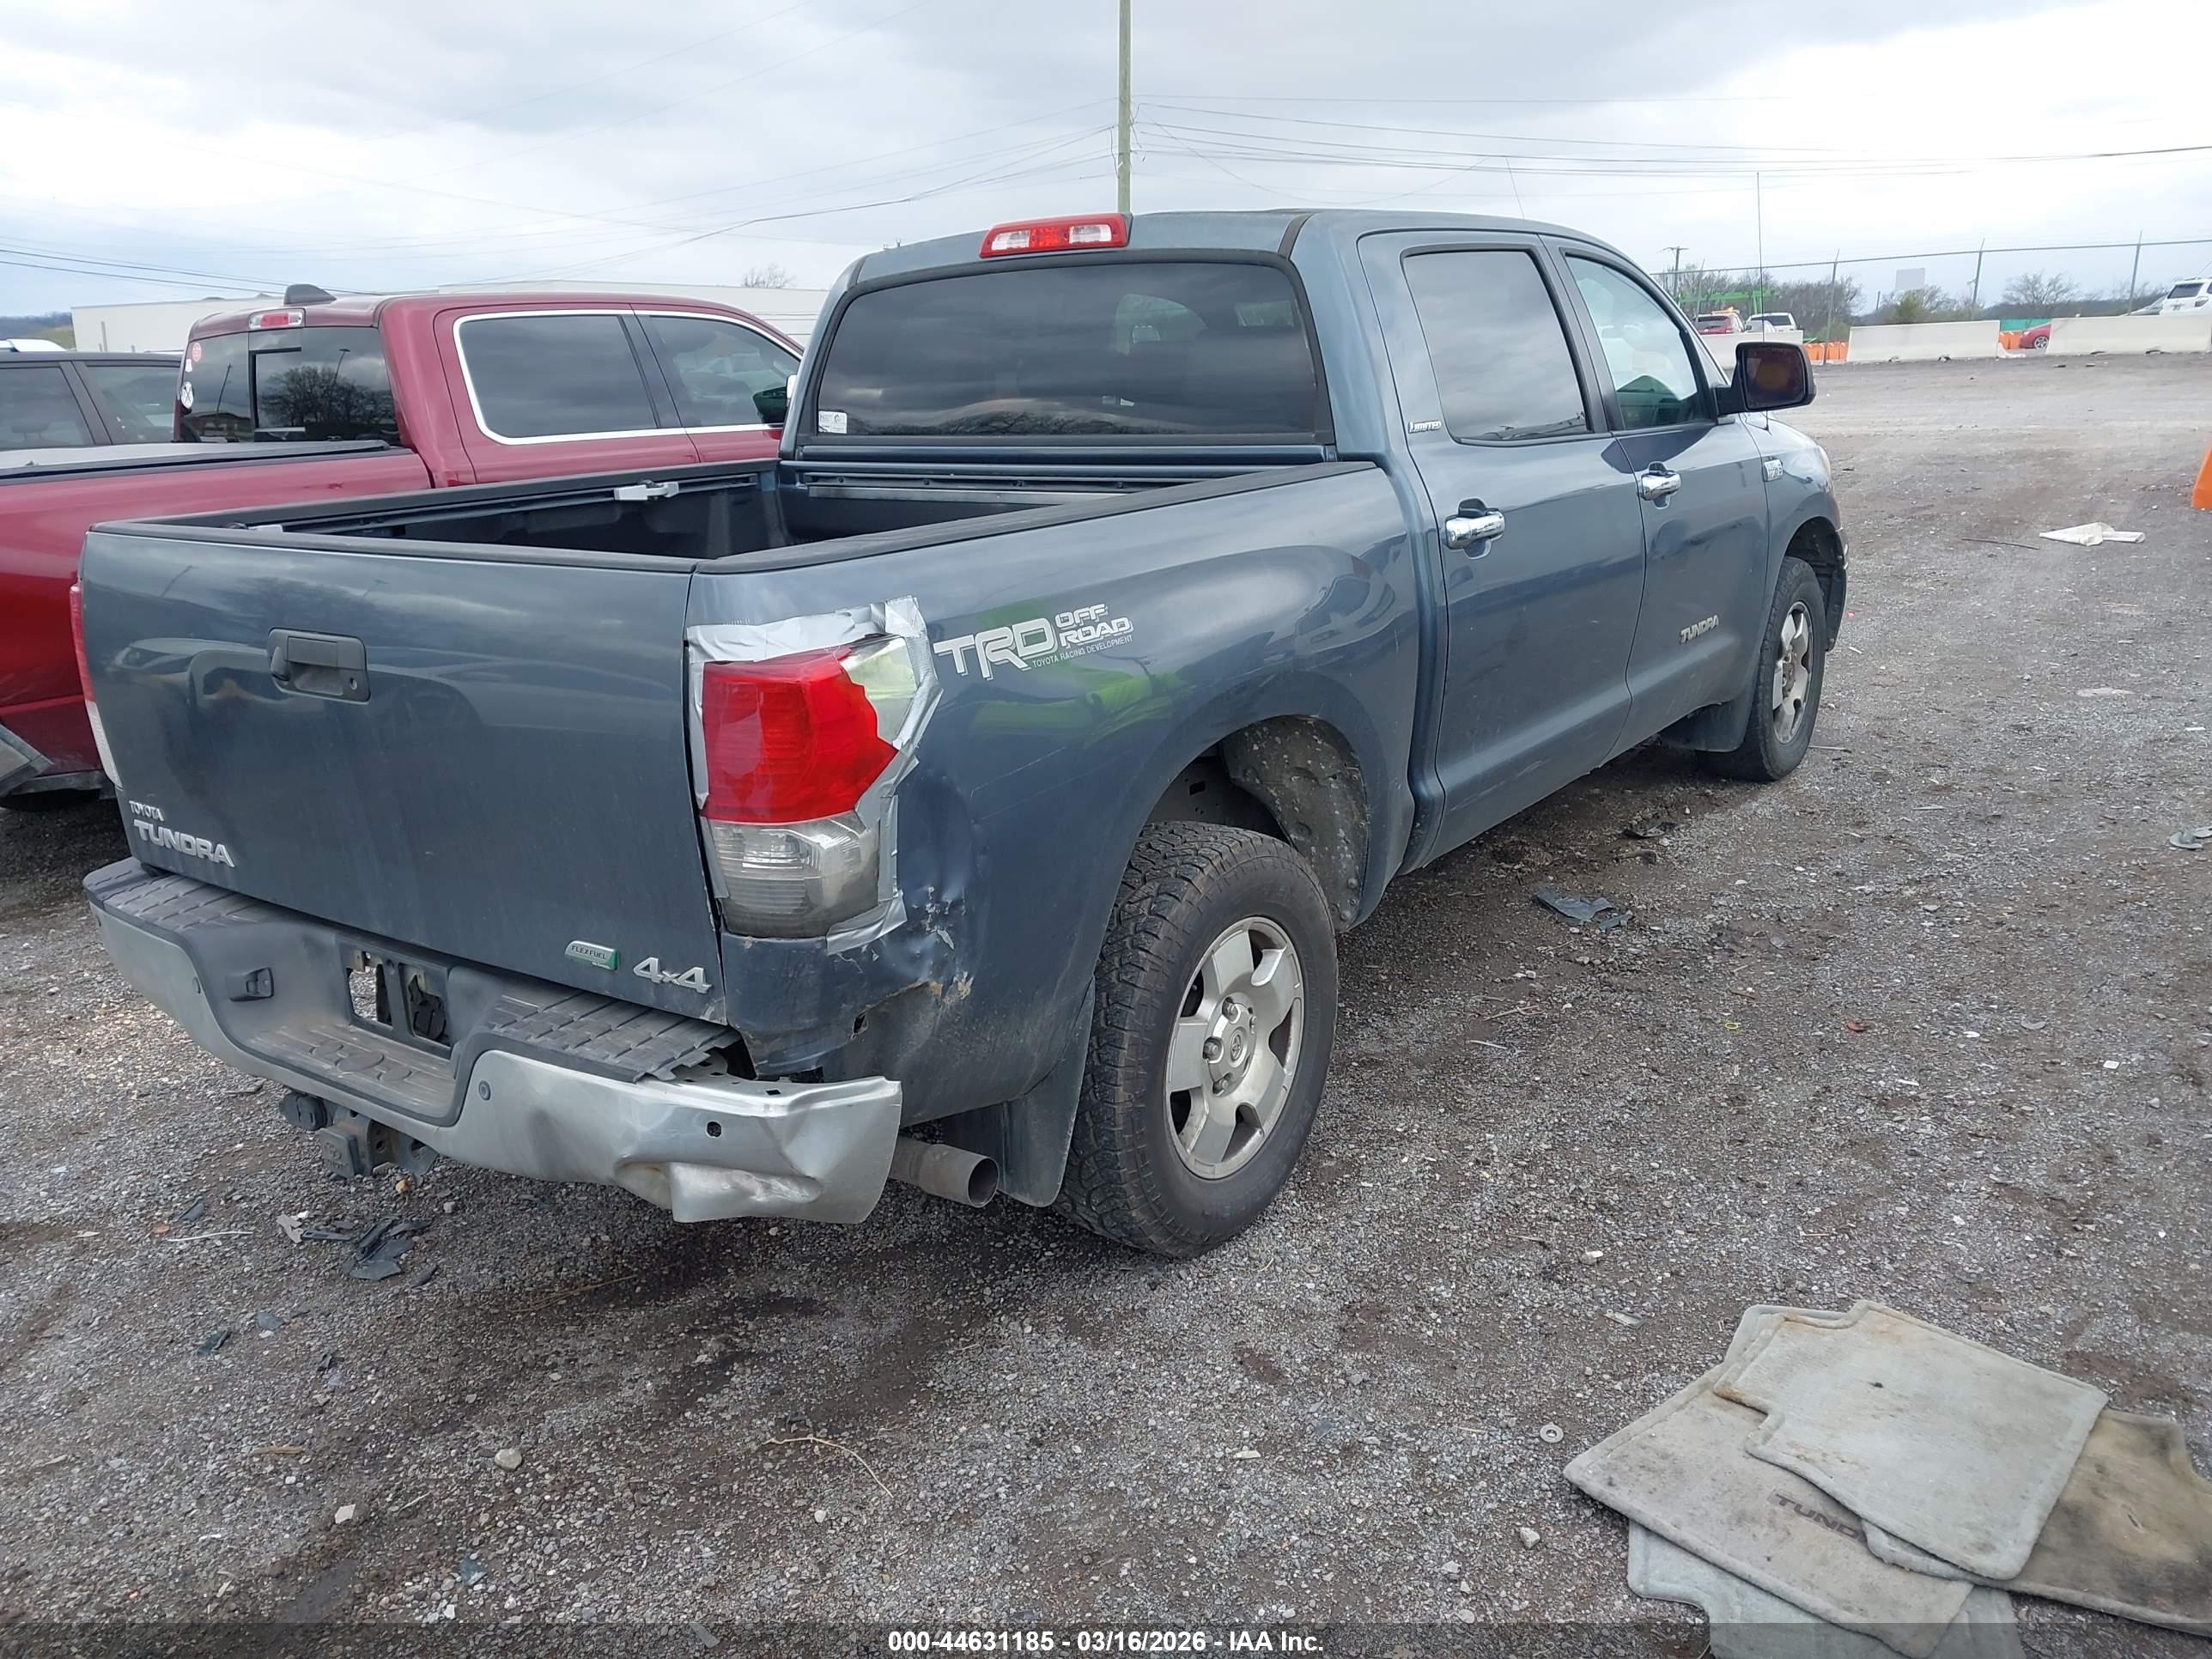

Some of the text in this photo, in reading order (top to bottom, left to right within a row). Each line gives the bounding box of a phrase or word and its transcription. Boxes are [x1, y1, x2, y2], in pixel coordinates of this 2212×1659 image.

[1055, 604, 1108, 629] OFF
[1681, 614, 1718, 643] TUNDRA
[933, 617, 1058, 680] TRD
[1059, 617, 1133, 649] ROAD
[1032, 635, 1133, 668] TOYOTA RACING DEVELOPMENT
[129, 800, 164, 821] TOYOTA
[134, 819, 235, 867] TUNDRA
[633, 957, 712, 994] 4x4
